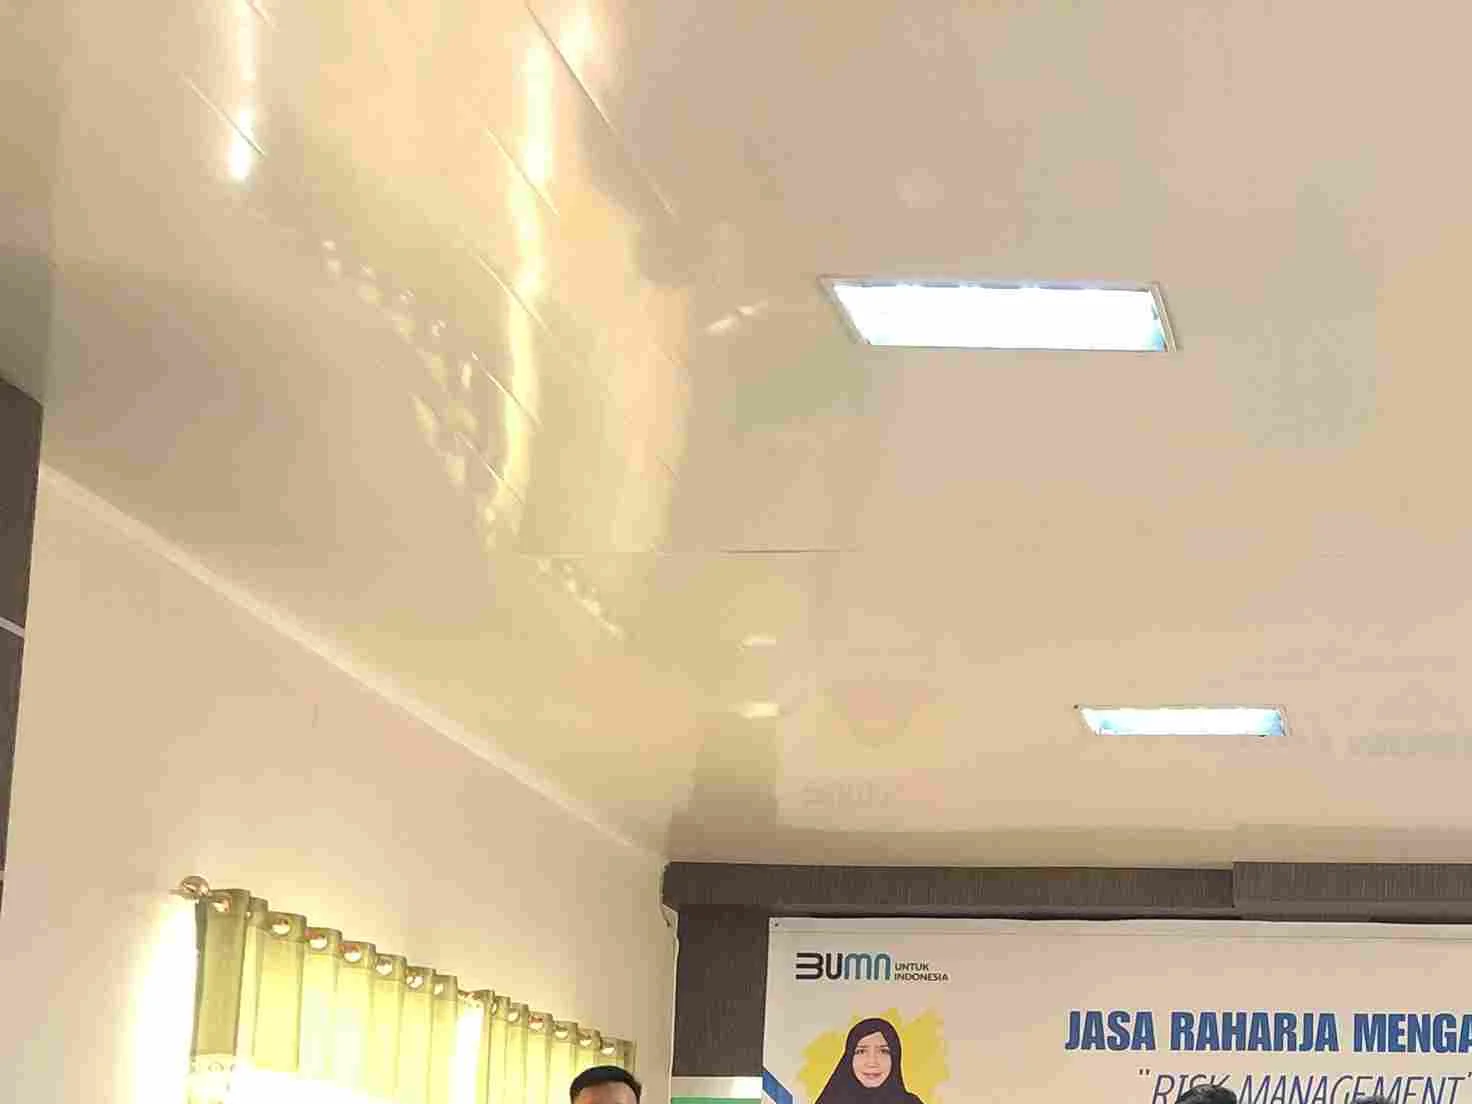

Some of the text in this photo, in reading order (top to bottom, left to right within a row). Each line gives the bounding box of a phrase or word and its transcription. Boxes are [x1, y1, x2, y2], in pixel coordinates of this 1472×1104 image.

[895, 962, 929, 971] UNTUK
[895, 973, 949, 982] INDONESIA
[1065, 1010, 1156, 1051] JASA
[1170, 1011, 1339, 1052] RAHARJA
